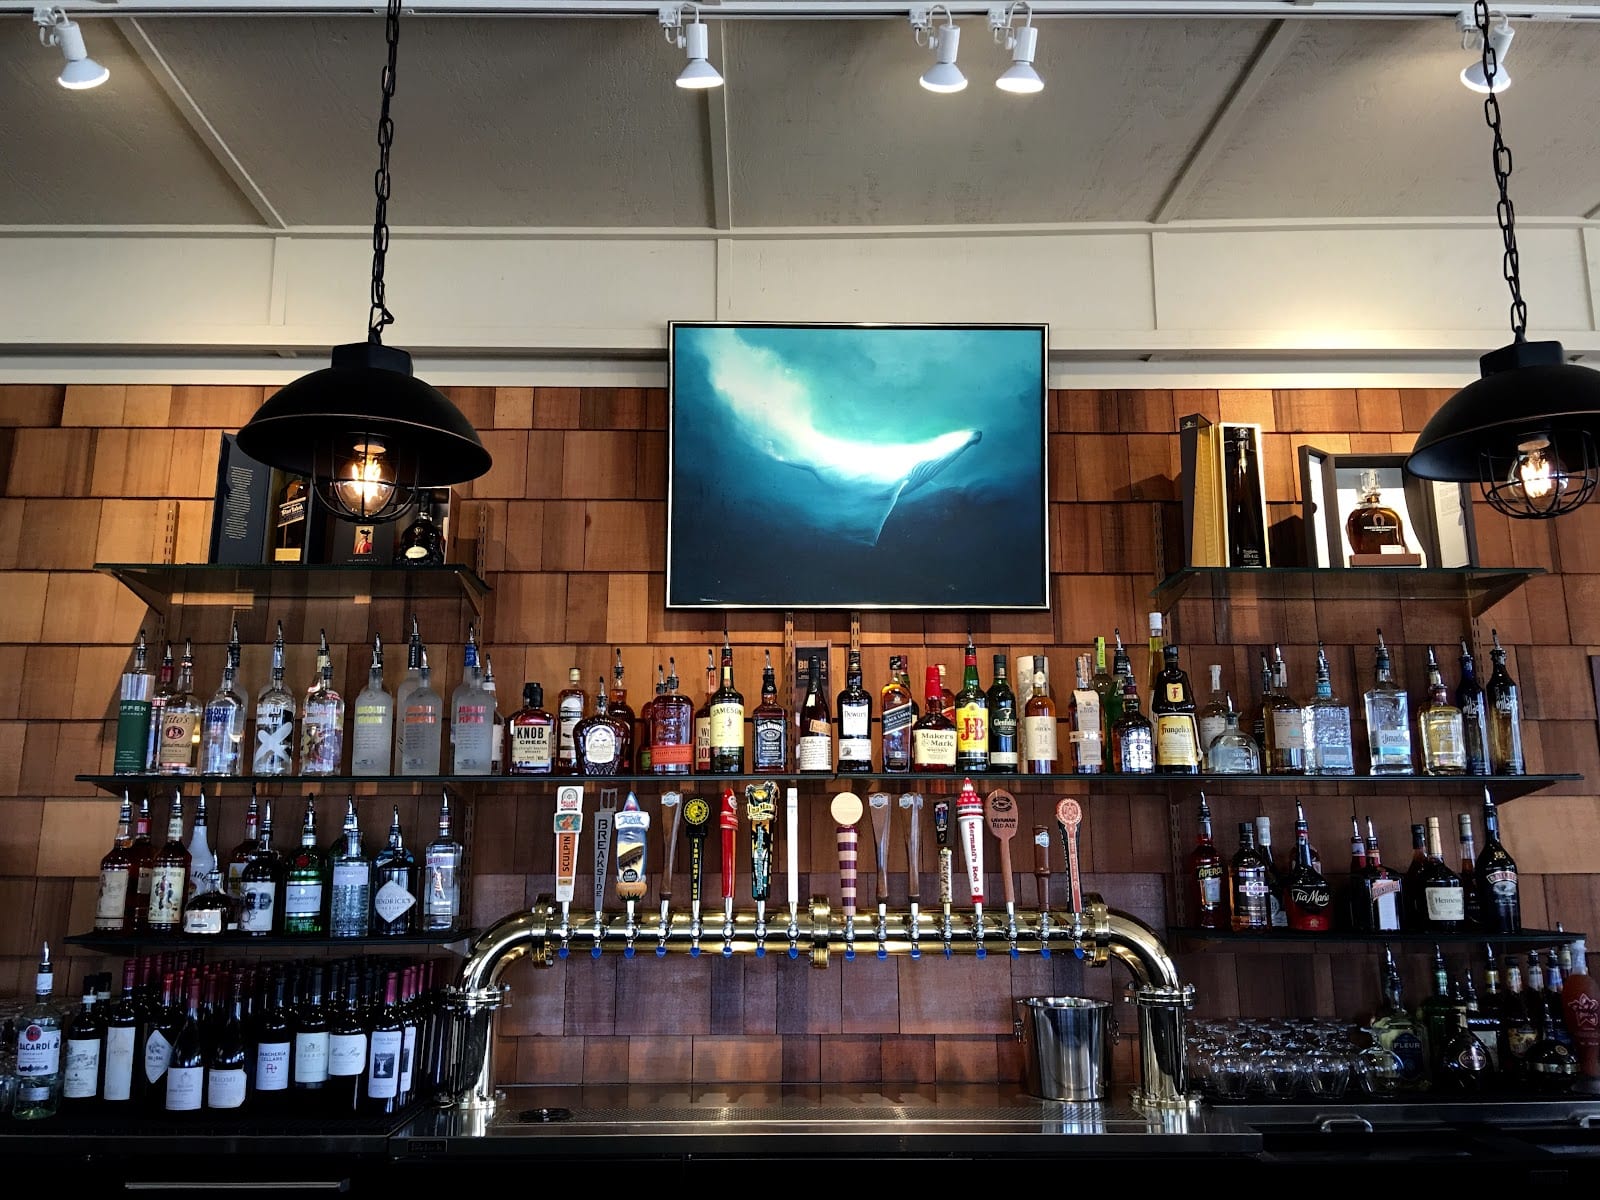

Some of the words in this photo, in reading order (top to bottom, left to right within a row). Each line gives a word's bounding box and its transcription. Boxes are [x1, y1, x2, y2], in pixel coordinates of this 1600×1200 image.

[357, 705, 386, 713] ABSOLUT
[713, 707, 742, 717] JAMESON
[165, 714, 192, 724] Tito's
[517, 728, 544, 739] KNOB
[701, 728, 710, 737] WI
[931, 740, 953, 748] Mark
[969, 821, 978, 863] Mermaid's
[562, 836, 571, 872] SCULPIN
[596, 819, 608, 897] BREAKSIDE
[972, 866, 980, 882] Red
[1199, 866, 1223, 878] APEROL
[288, 894, 318, 904] Tanqueray
[1296, 891, 1308, 903] Tia
